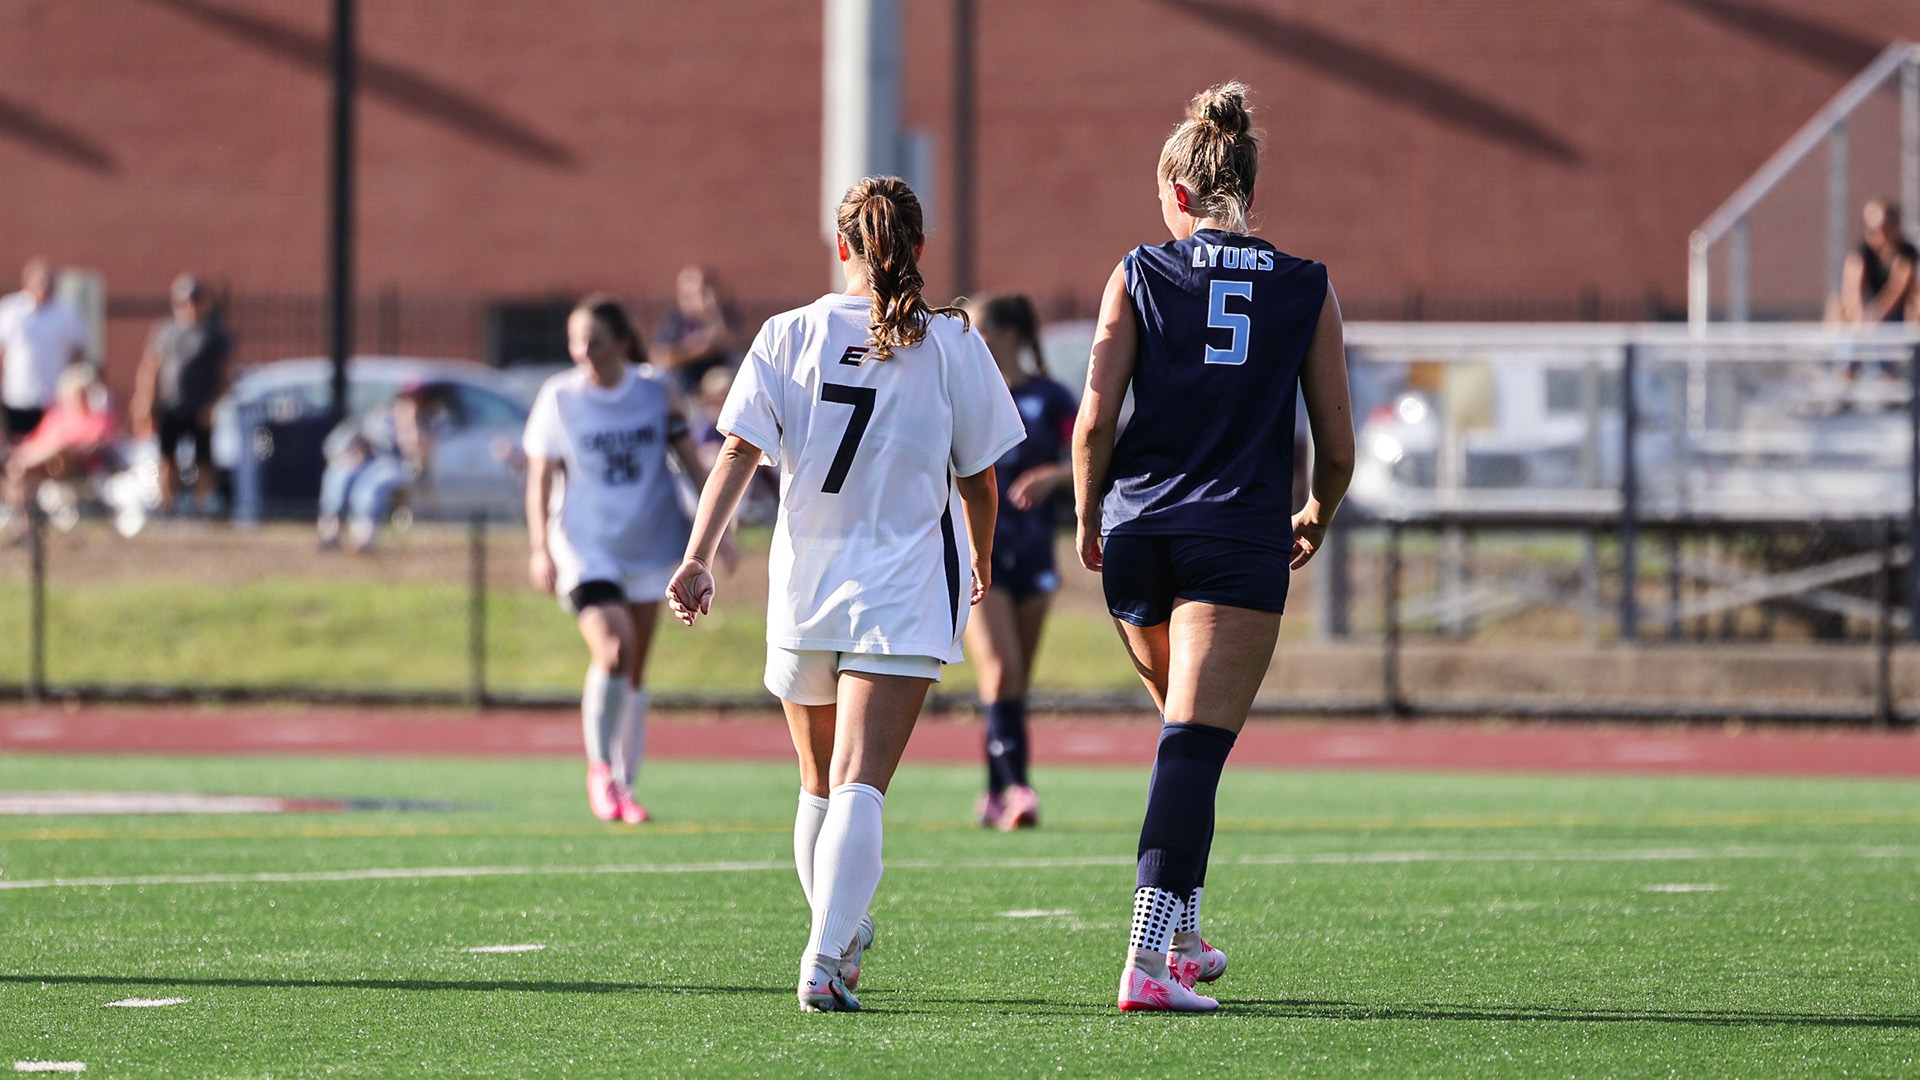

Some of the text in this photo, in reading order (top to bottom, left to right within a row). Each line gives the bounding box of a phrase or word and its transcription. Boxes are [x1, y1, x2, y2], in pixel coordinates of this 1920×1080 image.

[1192, 244, 1274, 271] LYONS
[1204, 280, 1253, 366] 5
[821, 382, 877, 494] 7
